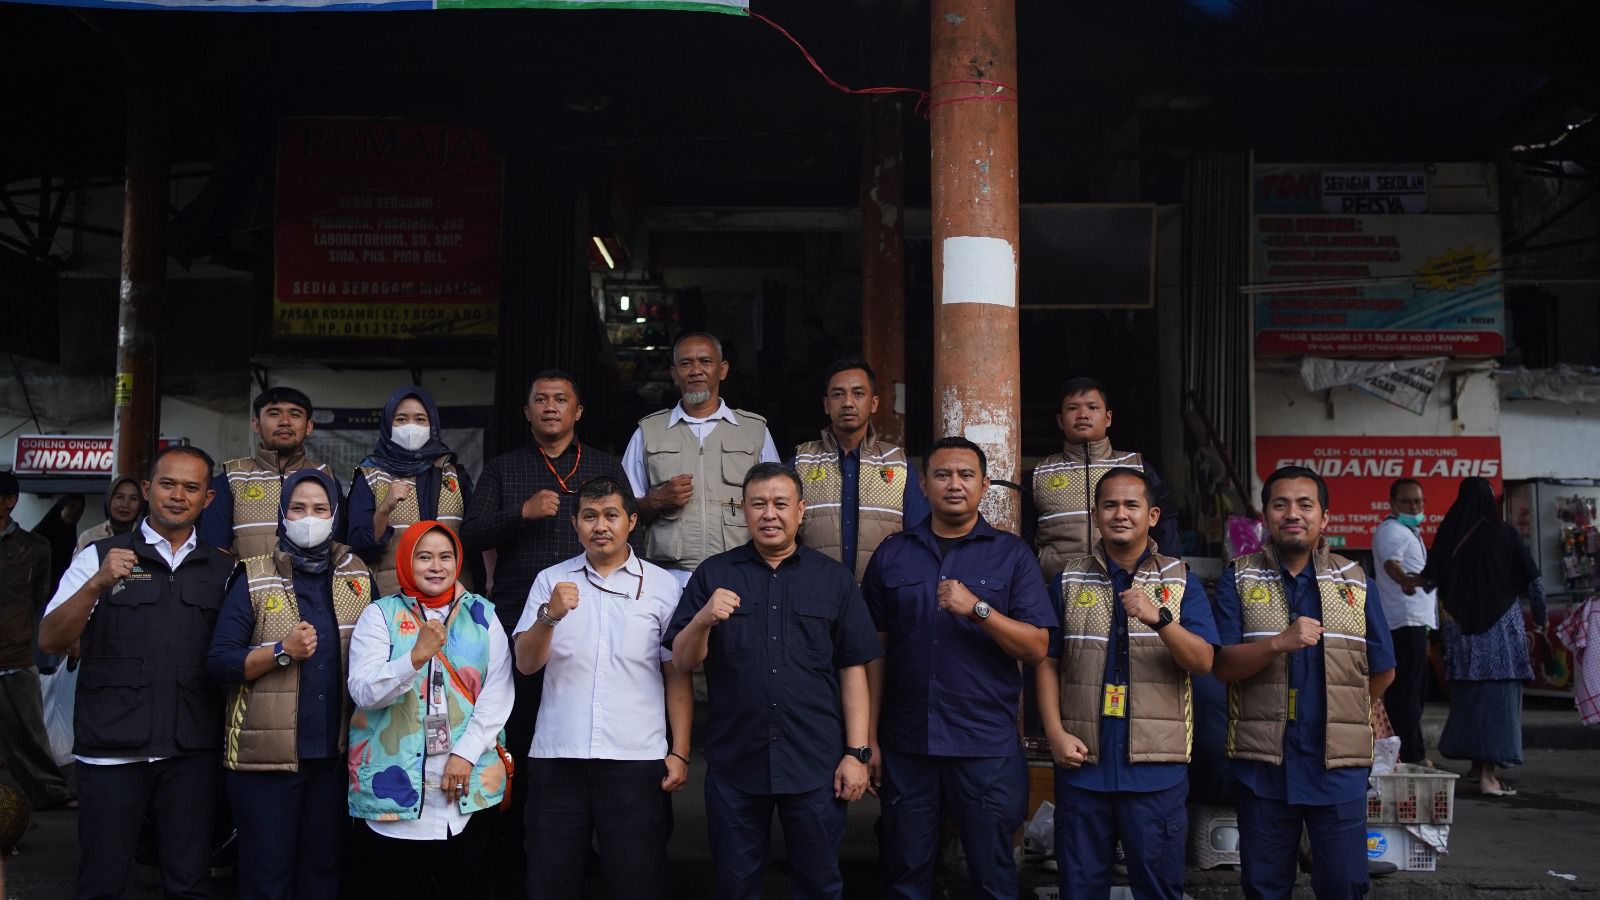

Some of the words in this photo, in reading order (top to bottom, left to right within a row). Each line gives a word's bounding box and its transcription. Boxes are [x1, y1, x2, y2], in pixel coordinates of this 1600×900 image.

[1377, 175, 1424, 190] SEKOLAH
[293, 281, 336, 294] SEDIA
[342, 281, 414, 294] SERAGAM
[280, 308, 318, 320] PASAR
[322, 308, 379, 320] KOSAMBI
[22, 440, 66, 450] GORENG
[69, 440, 108, 450] ONCOM
[1313, 448, 1341, 457] OLEH
[1350, 448, 1376, 457] OLEH
[1378, 448, 1405, 457] KHAS
[1407, 448, 1458, 457] BANDUNG
[20, 450, 114, 470] SINDANG
[1412, 458, 1500, 477] LARIS
[1371, 501, 1391, 511] SED
